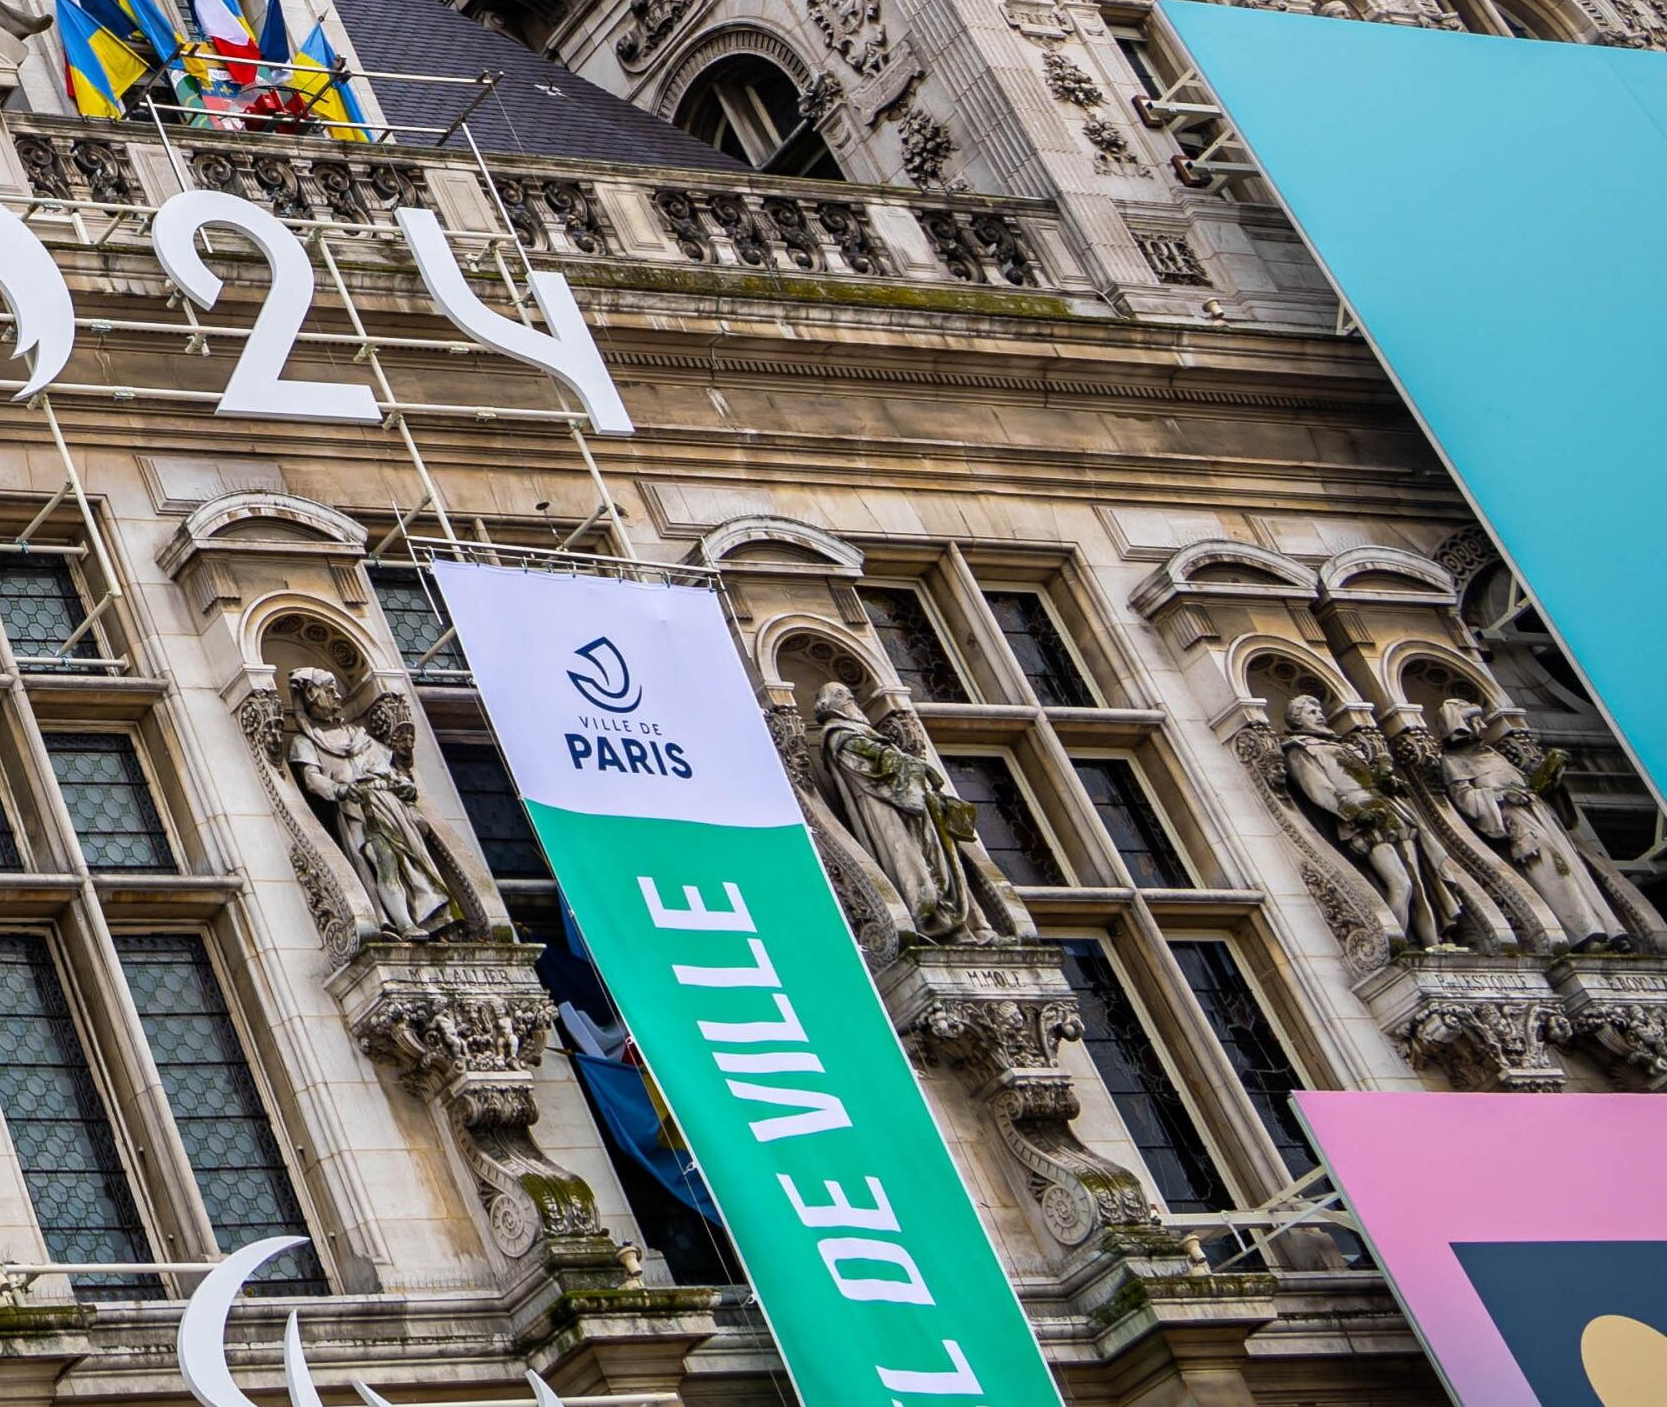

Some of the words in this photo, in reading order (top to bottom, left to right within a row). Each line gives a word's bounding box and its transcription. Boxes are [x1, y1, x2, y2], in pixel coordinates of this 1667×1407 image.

[564, 733, 693, 779] PARIS
[579, 715, 632, 732] VILLE
[639, 722, 662, 736] DE
[637, 876, 853, 1143] VILLE
[776, 1172, 936, 1306] DE
